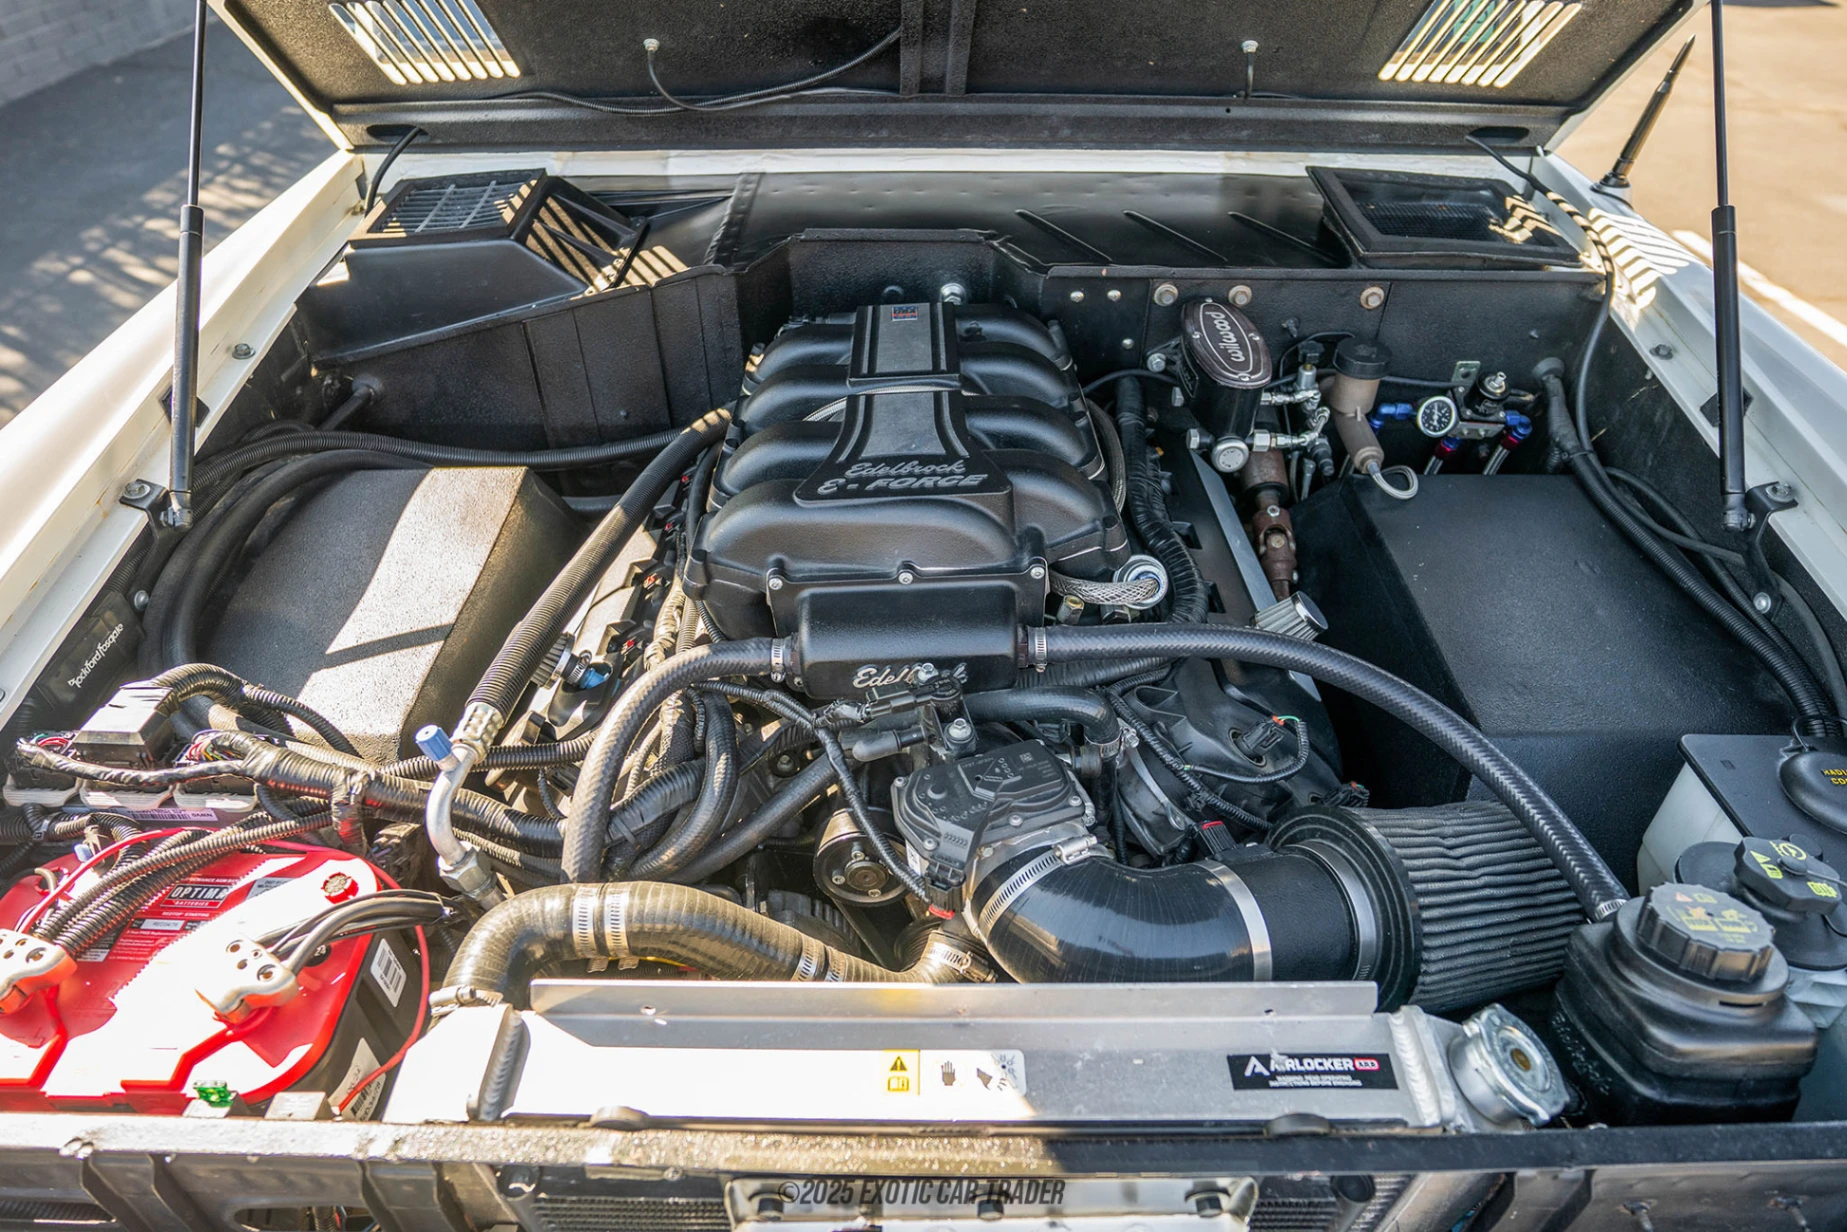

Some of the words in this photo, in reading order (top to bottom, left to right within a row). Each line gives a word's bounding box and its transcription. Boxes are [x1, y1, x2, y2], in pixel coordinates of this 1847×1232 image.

[1205, 311, 1245, 362] wilwood
[844, 459, 966, 478] Edelbrock
[171, 886, 229, 900] OPTIMA
